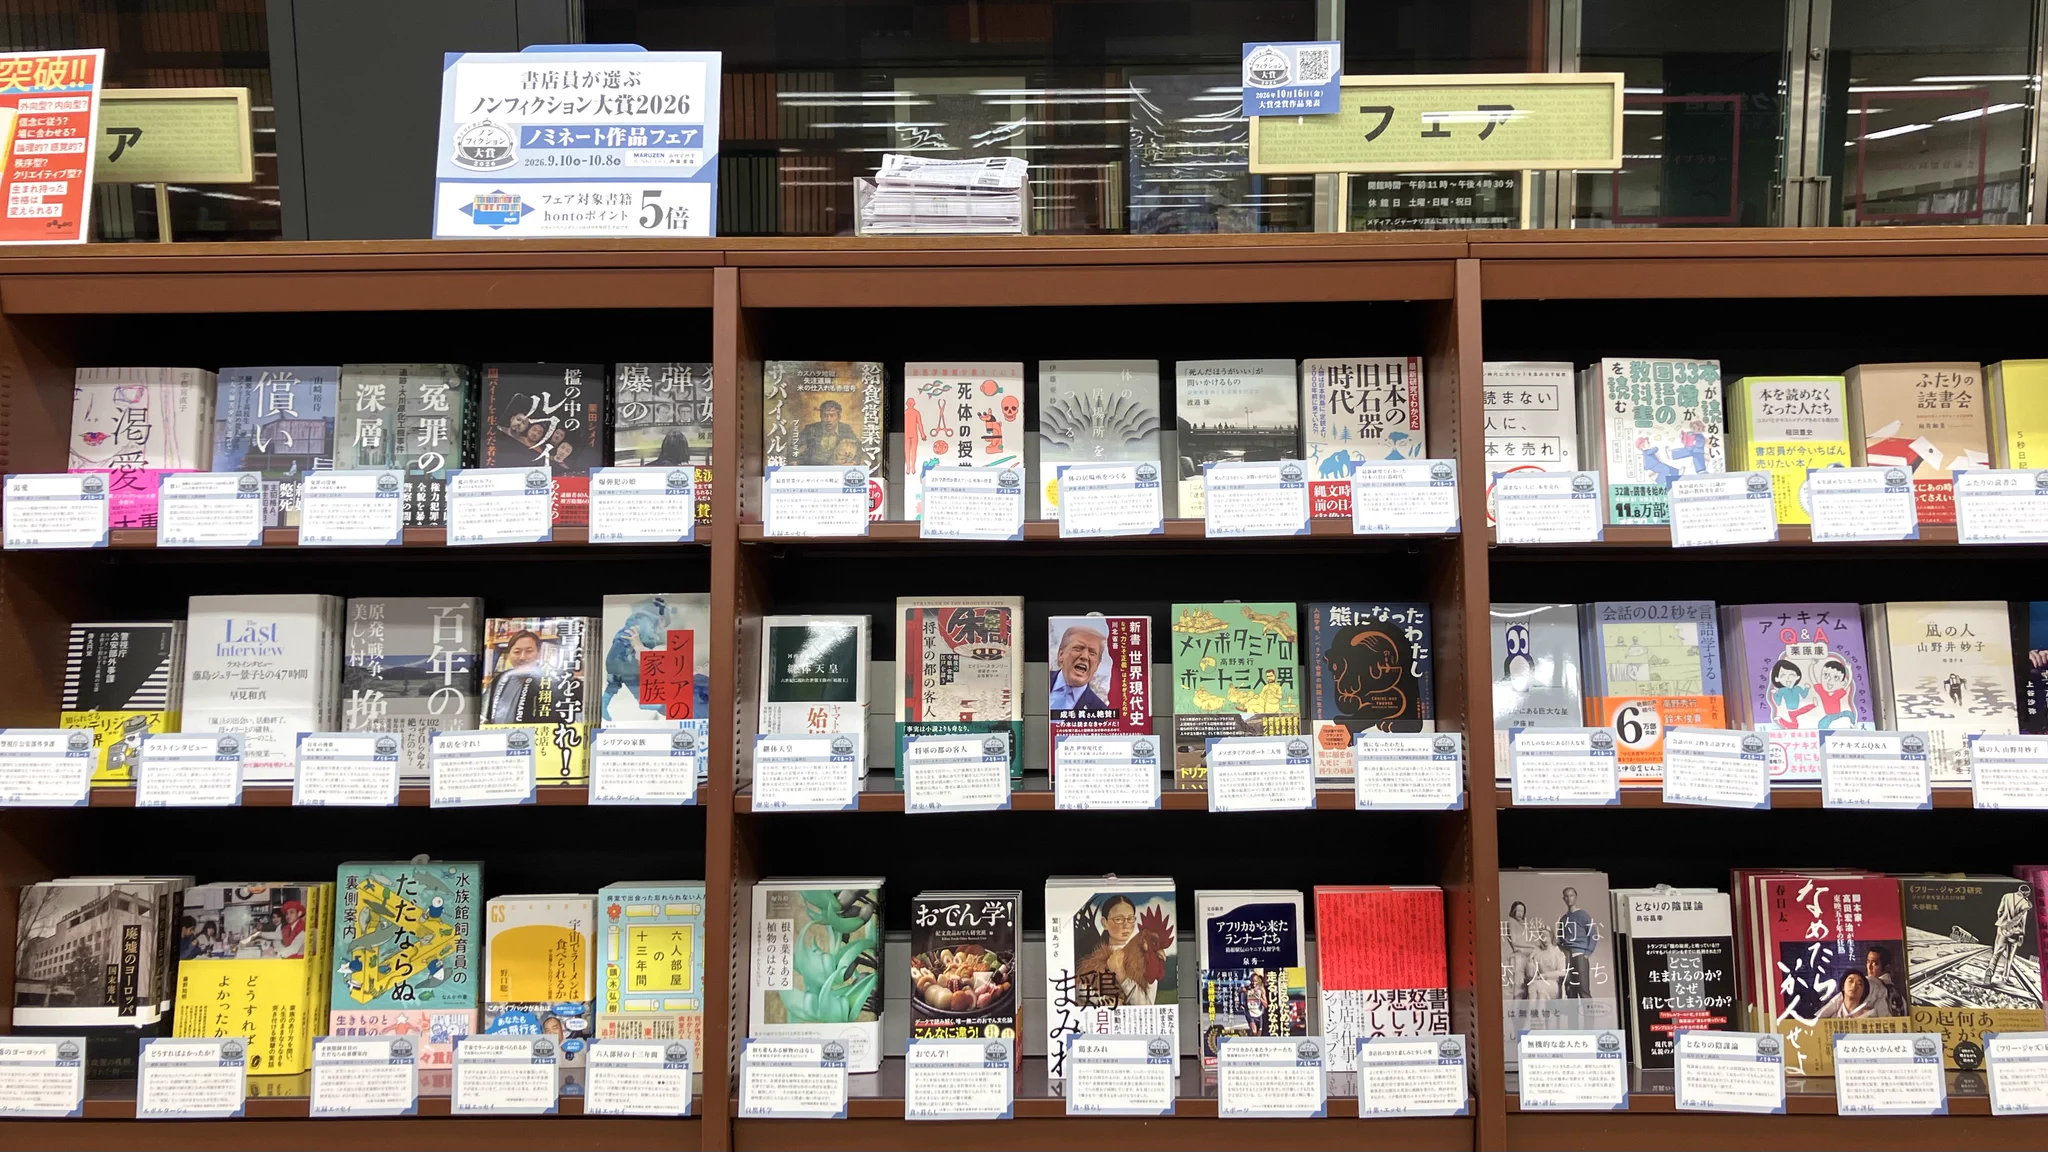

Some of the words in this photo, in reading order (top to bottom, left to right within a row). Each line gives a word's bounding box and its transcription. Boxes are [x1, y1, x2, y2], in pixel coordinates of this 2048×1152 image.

[520, 70, 642, 90] 書店員が選ぶ
[470, 94, 690, 116] ノンフィクション大賞2026
[526, 126, 698, 147] ノミネート作品フェア
[474, 148, 496, 158] 大賞
[542, 193, 632, 206] フェア対象書籍
[544, 210, 628, 221] hontoポイント
[1328, 364, 1354, 414] 時代
[1384, 364, 1406, 425] 日本の
[1608, 362, 1630, 413] を読む
[1630, 361, 1654, 427] 教科書
[1653, 362, 1676, 424] 国語の
[1675, 363, 1699, 421] 33歳が
[1760, 388, 1830, 401] 本を読めなく
[1916, 373, 1974, 388] ふたりの
[252, 371, 300, 452] 償い
[353, 384, 385, 447] 深層
[564, 369, 582, 431] 檻の中の
[1064, 390, 1074, 437] つくる
[1356, 364, 1383, 438] 旧石器
[1698, 363, 1721, 458] 本が読めない
[1762, 403, 1832, 415] なった人たち
[1917, 391, 1972, 409] 読書会
[418, 384, 449, 473] 冤罪の
[861, 364, 881, 475] 給食営業マン
[1093, 388, 1104, 456] 居場所を
[1485, 443, 1569, 457] 本を売れ。
[1755, 446, 1845, 456] 書店員が今いちばん
[225, 619, 280, 642] Last
[1330, 606, 1424, 626] 熊になった
[1759, 611, 1847, 633] アナキズム
[1926, 624, 1975, 638] 凪の人
[350, 604, 367, 666] 美しい村
[367, 604, 385, 680] 原発、戦争、
[1130, 622, 1140, 645] 新書
[1180, 629, 1293, 660] メソポタミアの
[1780, 628, 1829, 644] Q&A
[1917, 642, 1985, 653] 山野井妙子
[217, 644, 284, 656] Interview
[427, 603, 470, 714] 百年の
[1405, 626, 1428, 678] わたし
[1791, 647, 1824, 656] 栗原康
[192, 670, 308, 680] 藤島ジュリー景子との47時間
[643, 655, 666, 702] 家族
[669, 634, 690, 719] シリアの
[923, 622, 937, 717] 将軍の都の客人
[230, 692, 266, 700] 早見和真
[554, 618, 585, 776] 書店を守れ!
[1129, 651, 1144, 726] 世界現代史
[1617, 707, 1642, 743] 6
[343, 875, 358, 939] 裏側案内
[491, 905, 505, 922] GS
[916, 901, 1013, 927] おでん学!
[1635, 901, 1703, 911] となりの陰謀論
[391, 874, 417, 1001] ただならぬ
[453, 873, 470, 984] 水族館飼育員の
[1216, 922, 1288, 932] アフリカから来た
[1225, 934, 1280, 944] ランナーたち
[555, 939, 566, 999] 食べられるか
[569, 919, 581, 999] 宇宙でラーメンは
[636, 931, 648, 986] 十三年間
[654, 951, 664, 961] の
[670, 931, 682, 986] 六人部屋
[766, 922, 776, 986] 植物のはなし
[781, 922, 791, 987] 根も葉もある
[1669, 958, 1700, 968] どこで
[122, 927, 138, 1014] 廃墟のヨーロッパ
[1649, 970, 1722, 982] 生まれるのか?
[1642, 996, 1731, 1009] 信じてしまうのか?
[1675, 983, 1697, 994] なぜ
[336, 1016, 388, 1025] 生きものと
[1843, 1045, 1907, 1053] なめたらいかんぜよ
